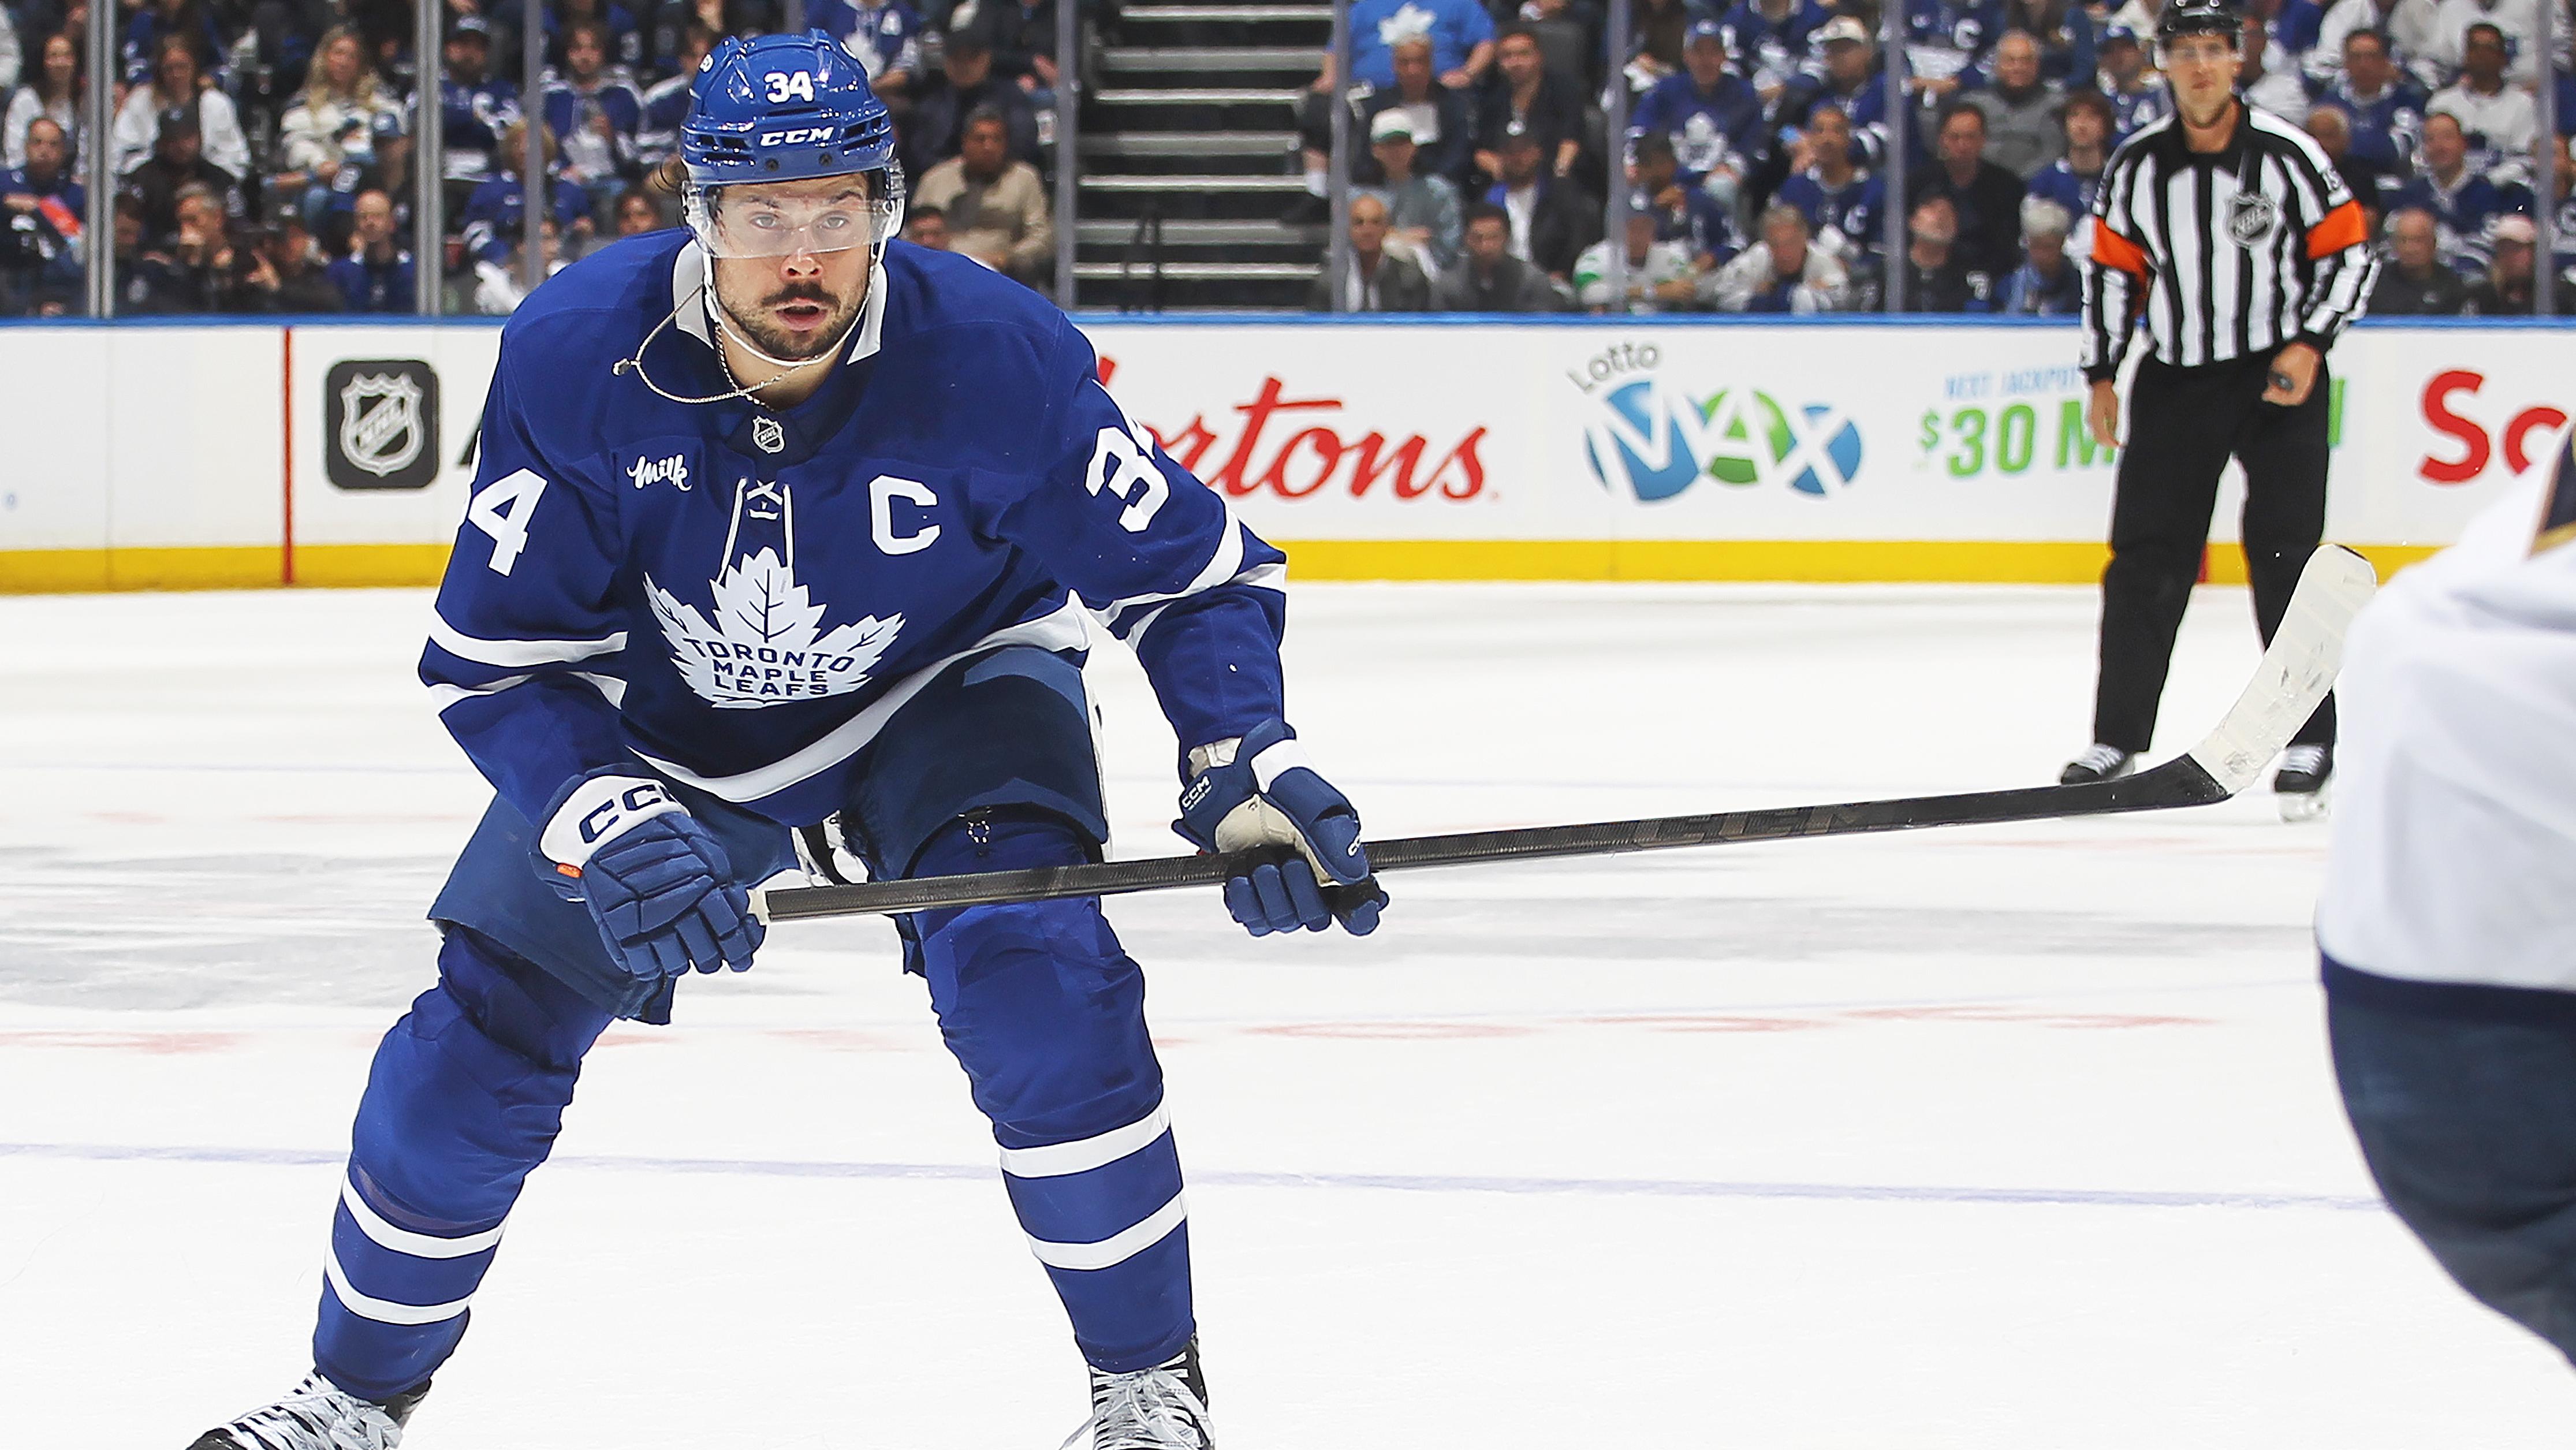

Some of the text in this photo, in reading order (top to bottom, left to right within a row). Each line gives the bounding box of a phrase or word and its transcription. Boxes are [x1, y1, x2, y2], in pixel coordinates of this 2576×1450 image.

[763, 71, 814, 103] 34
[760, 126, 834, 147] CCM
[1567, 341, 1659, 393] Lotto
[1099, 356, 1487, 500] rtons
[1917, 402, 2036, 478] $30
[627, 454, 692, 491] Milk
[1085, 417, 1170, 532] 3
[869, 475, 941, 556] C
[683, 637, 855, 673] TORONTO
[712, 658, 827, 683] MAPLE
[714, 673, 829, 696] LEAFS
[1181, 776, 1210, 808] CCM
